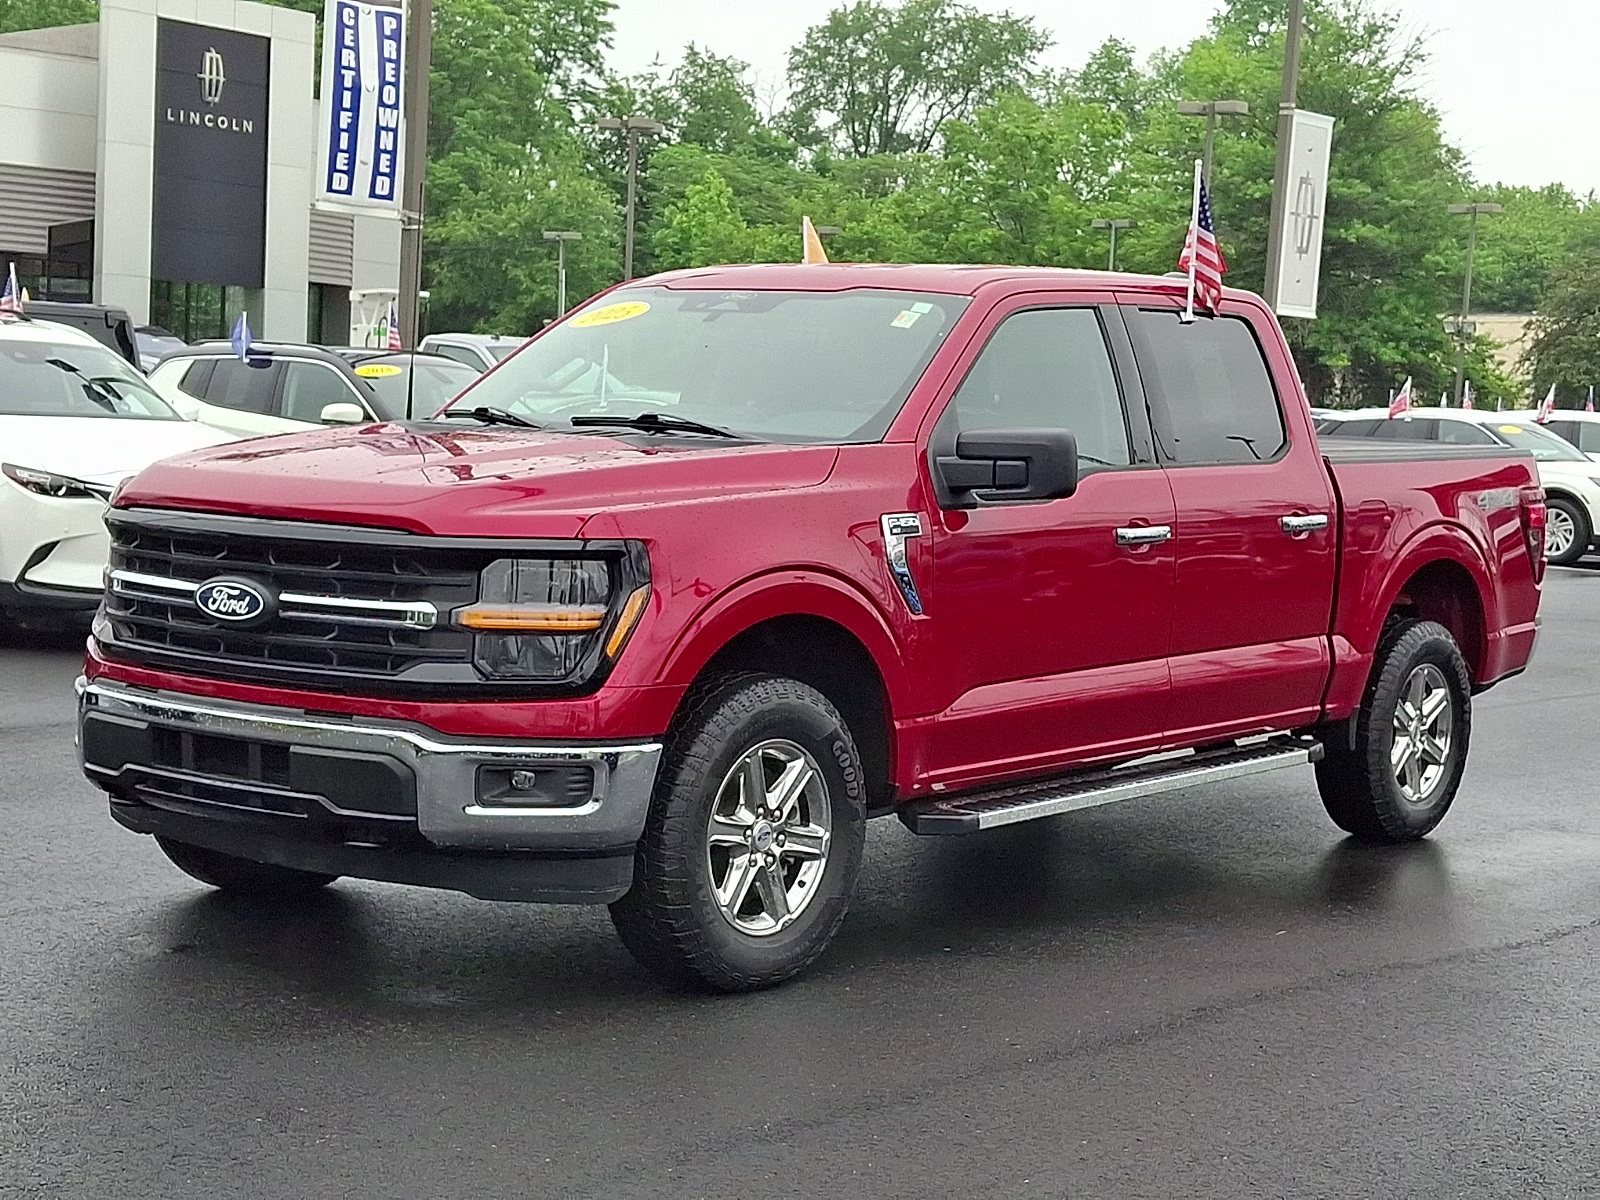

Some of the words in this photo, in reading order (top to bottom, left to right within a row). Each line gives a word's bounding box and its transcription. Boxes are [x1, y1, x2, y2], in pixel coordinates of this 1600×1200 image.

[166, 107, 253, 133] LINCOLN
[331, 6, 356, 191] CERTIFIED
[374, 15, 399, 196] PREOWNED
[207, 586, 250, 614] Ford
